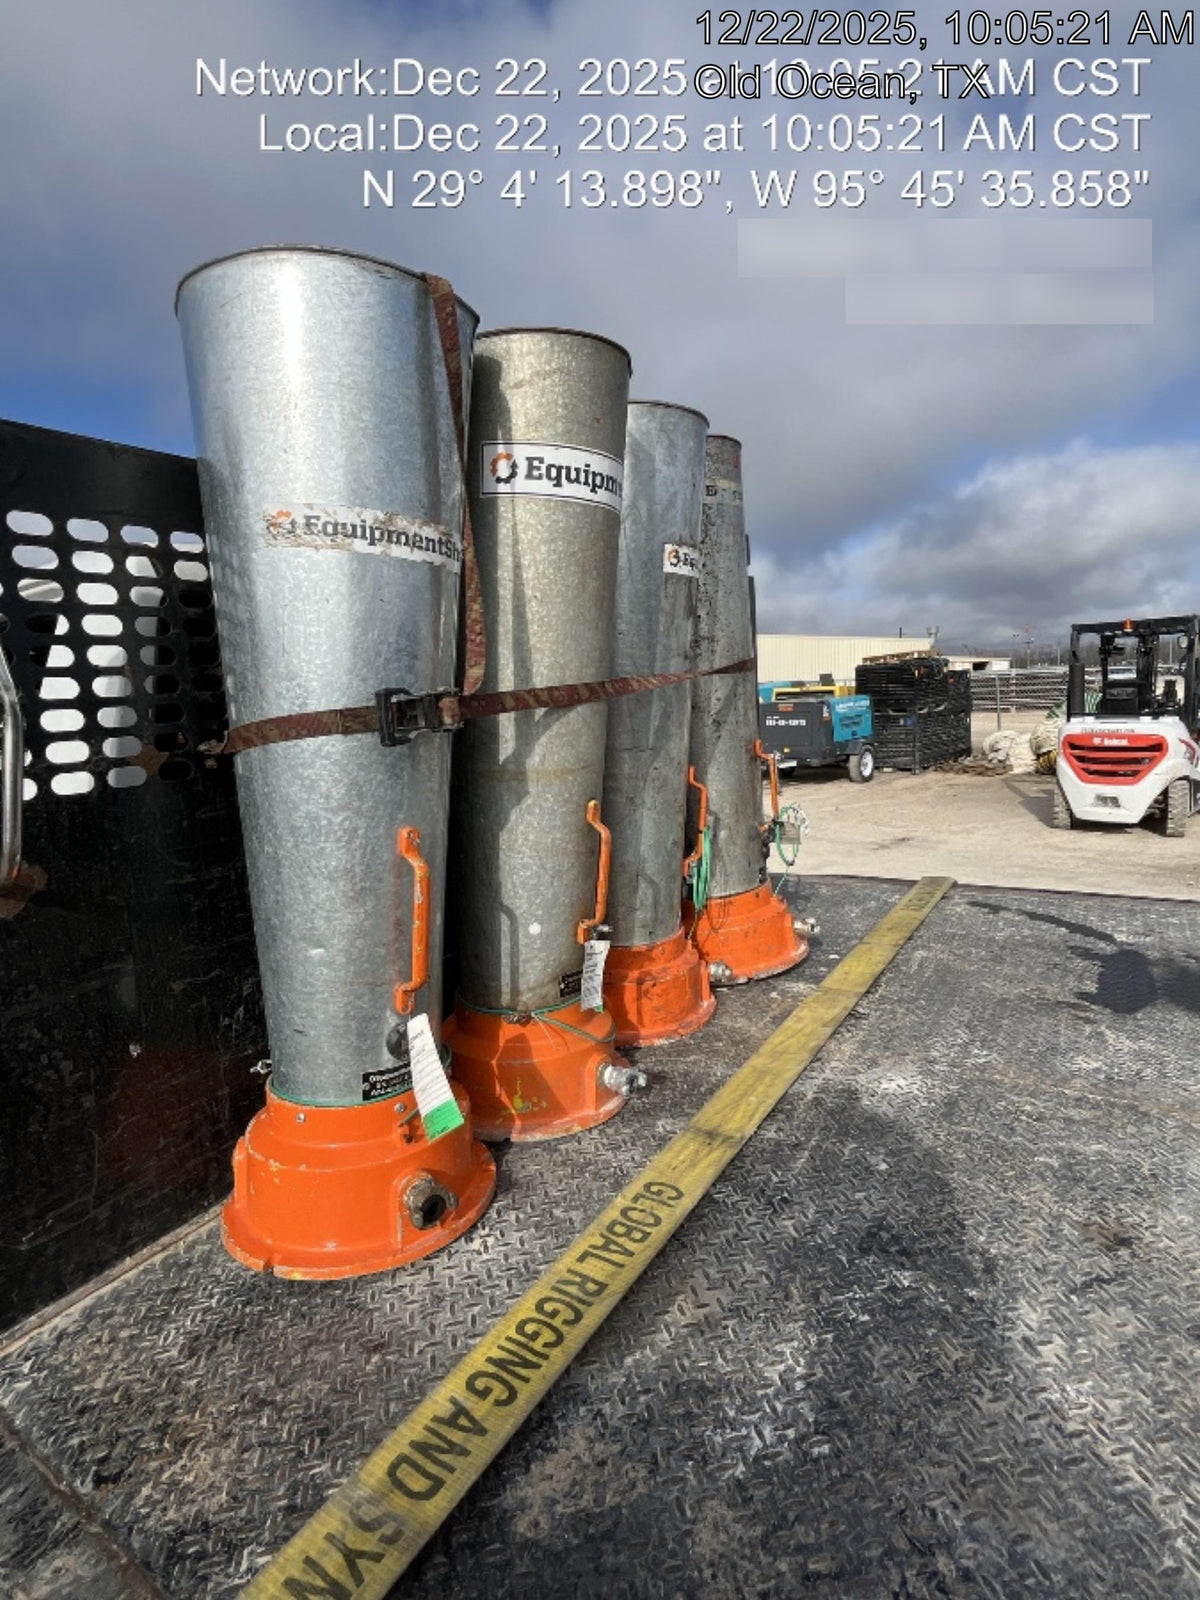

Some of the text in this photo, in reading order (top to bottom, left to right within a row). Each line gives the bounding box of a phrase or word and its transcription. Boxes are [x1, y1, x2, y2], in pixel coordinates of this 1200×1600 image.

[523, 456, 621, 497] Equipm
[575, 1181, 685, 1268] GLOBAL
[464, 1267, 609, 1407] RIGGING
[386, 1395, 489, 1501] AND
